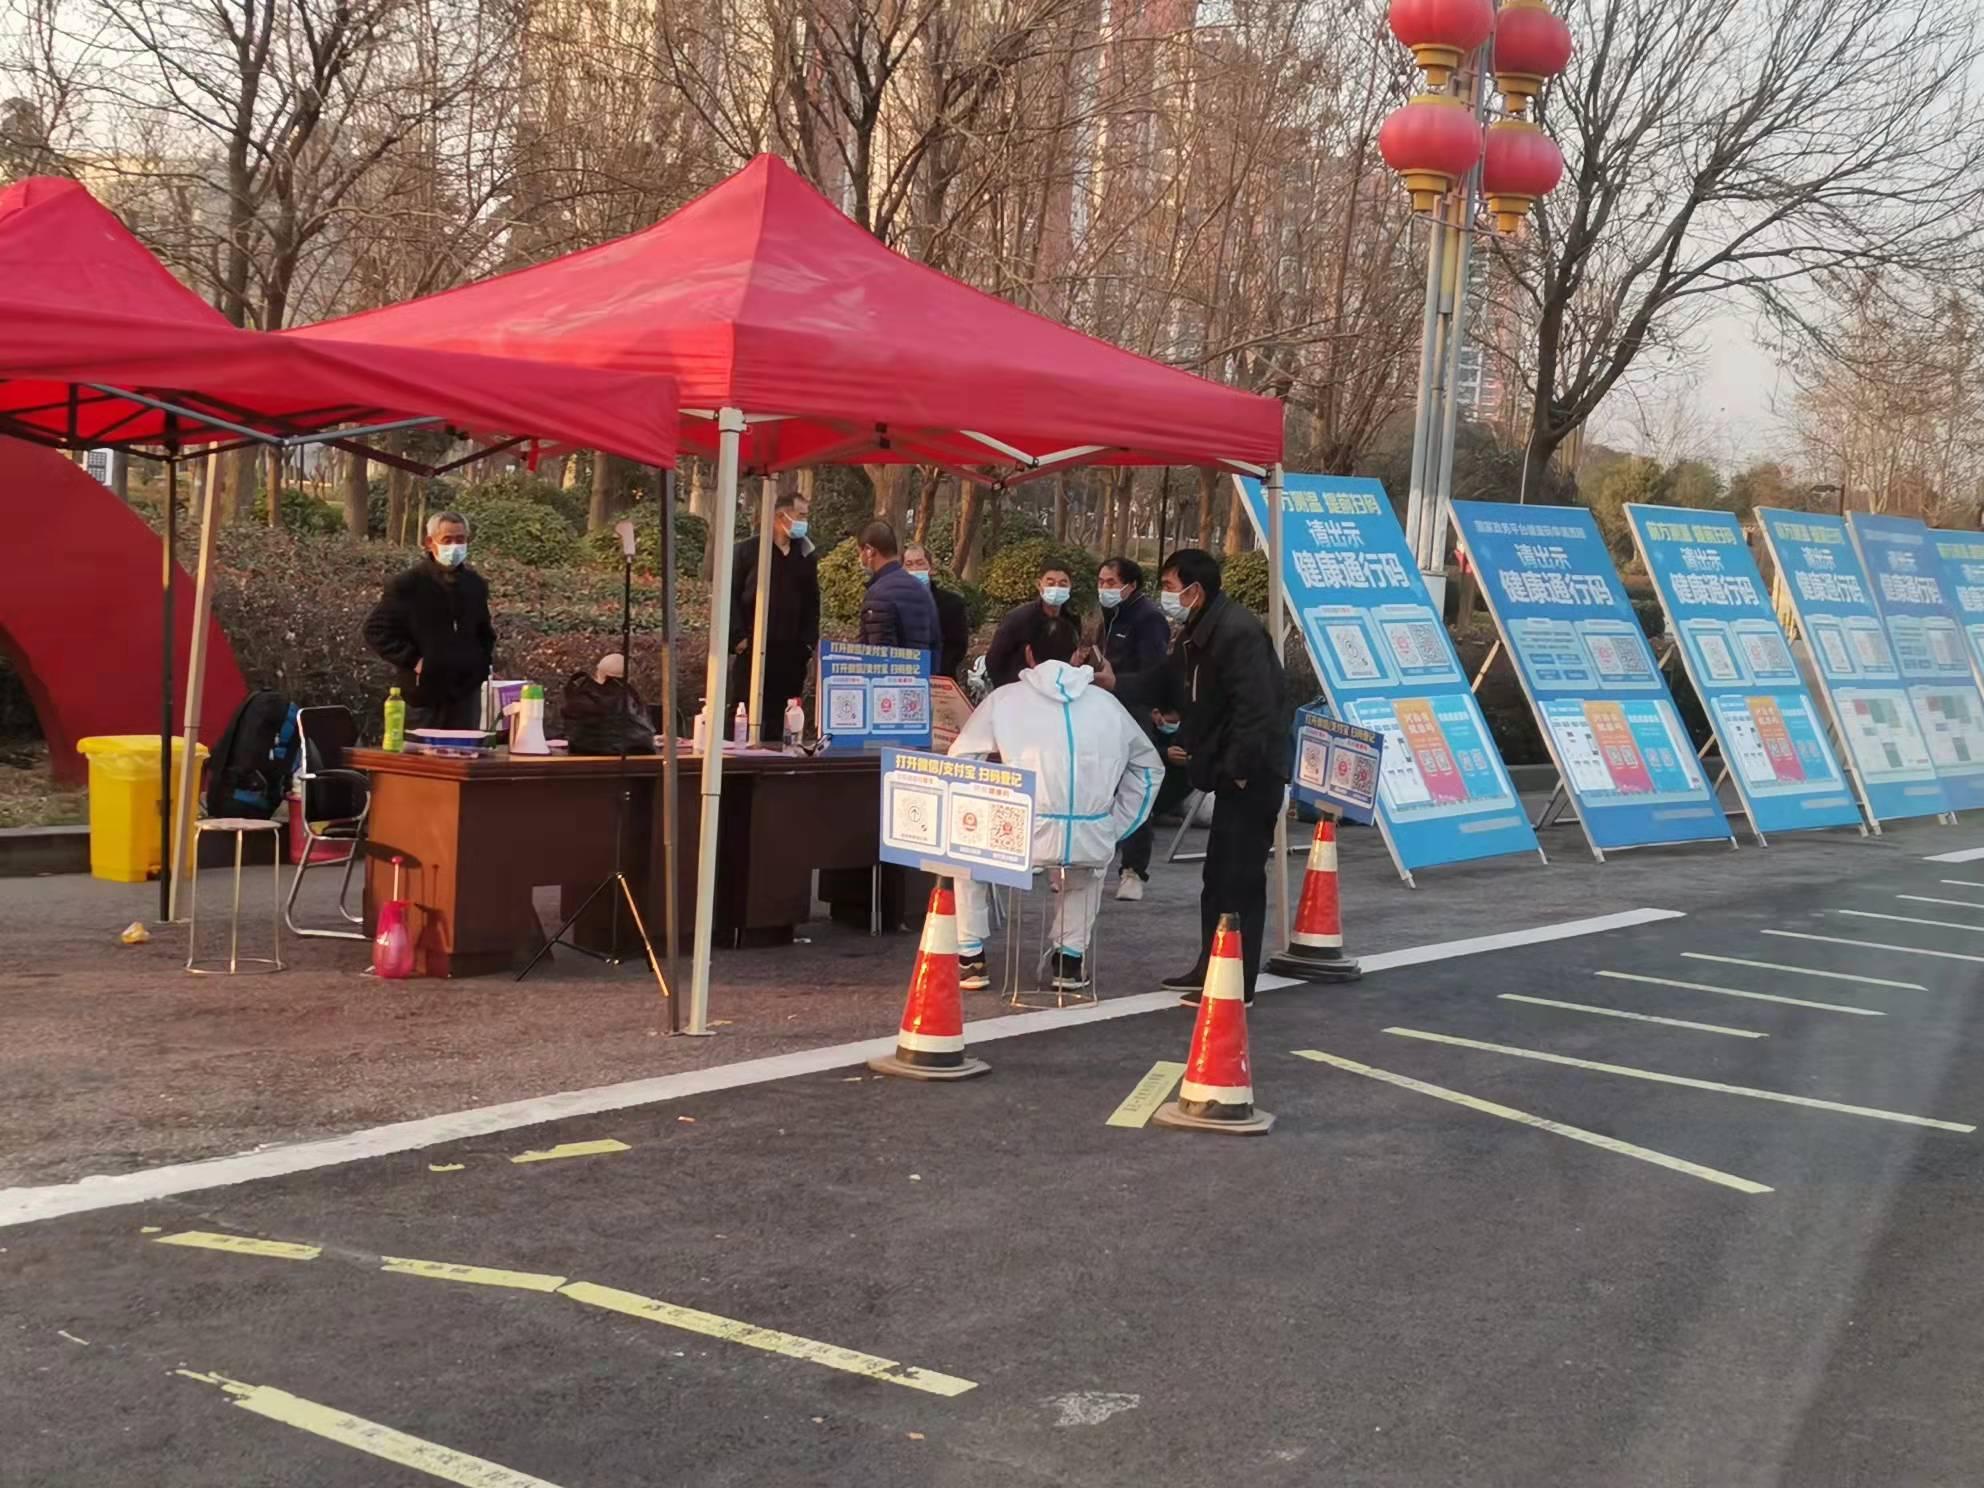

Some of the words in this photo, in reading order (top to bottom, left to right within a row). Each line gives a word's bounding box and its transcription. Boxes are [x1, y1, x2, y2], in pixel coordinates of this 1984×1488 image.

[1305, 519, 1365, 549] 请出示
[1292, 550, 1411, 589] 健康通行码
[1513, 543, 1572, 570] 请出示
[1680, 546, 1725, 572] 请出示
[1498, 569, 1615, 606] 健康通行码
[1669, 571, 1761, 606] 健康通行码
[895, 754, 977, 779] 打开微信/支付宝
[978, 766, 1023, 788] 扫码登记
